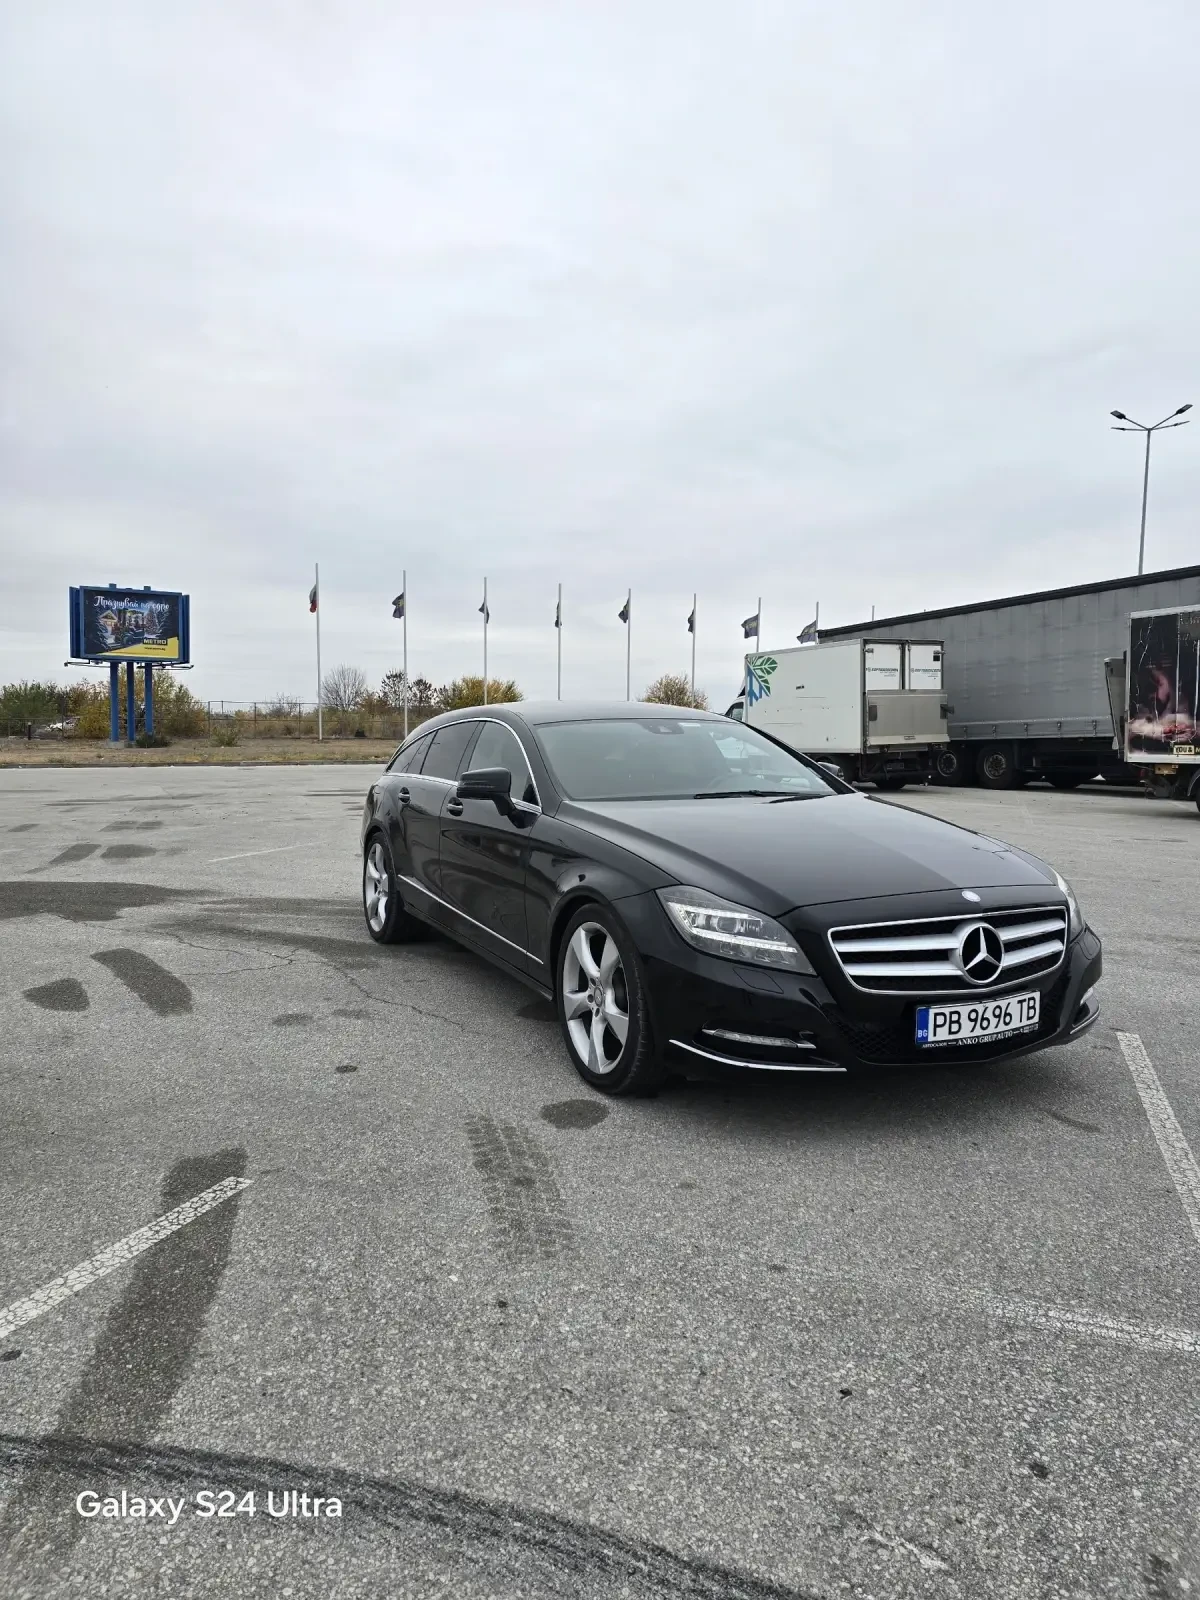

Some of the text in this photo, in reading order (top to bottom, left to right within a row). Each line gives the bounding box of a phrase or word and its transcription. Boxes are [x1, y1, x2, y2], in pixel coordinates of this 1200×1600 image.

[932, 996, 1037, 1037] PB 9696 TB
[918, 1029, 928, 1038] BG
[956, 1036, 978, 1046] ANKO
